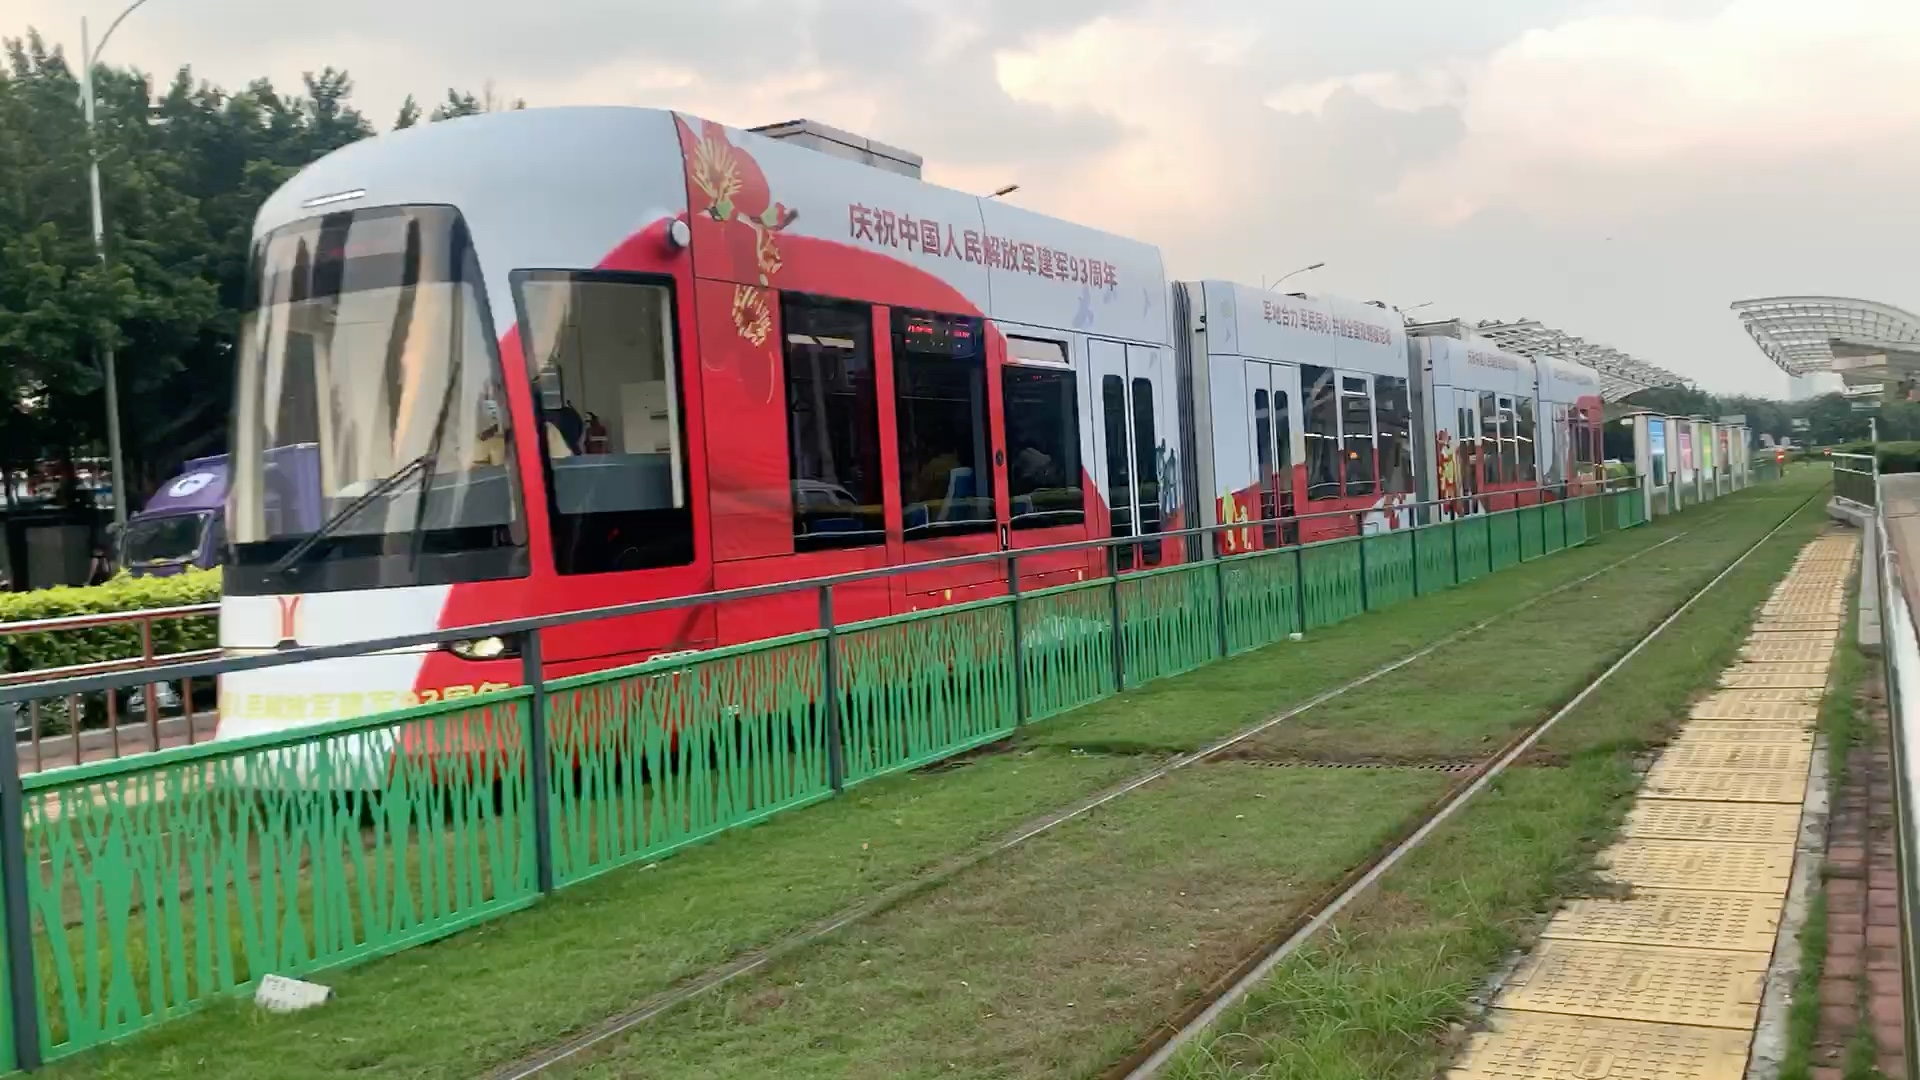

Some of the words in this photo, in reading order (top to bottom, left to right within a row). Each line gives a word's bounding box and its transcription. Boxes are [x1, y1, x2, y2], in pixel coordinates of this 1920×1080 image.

[848, 202, 1118, 291] 庆祝中国人民解放军建军93周年
